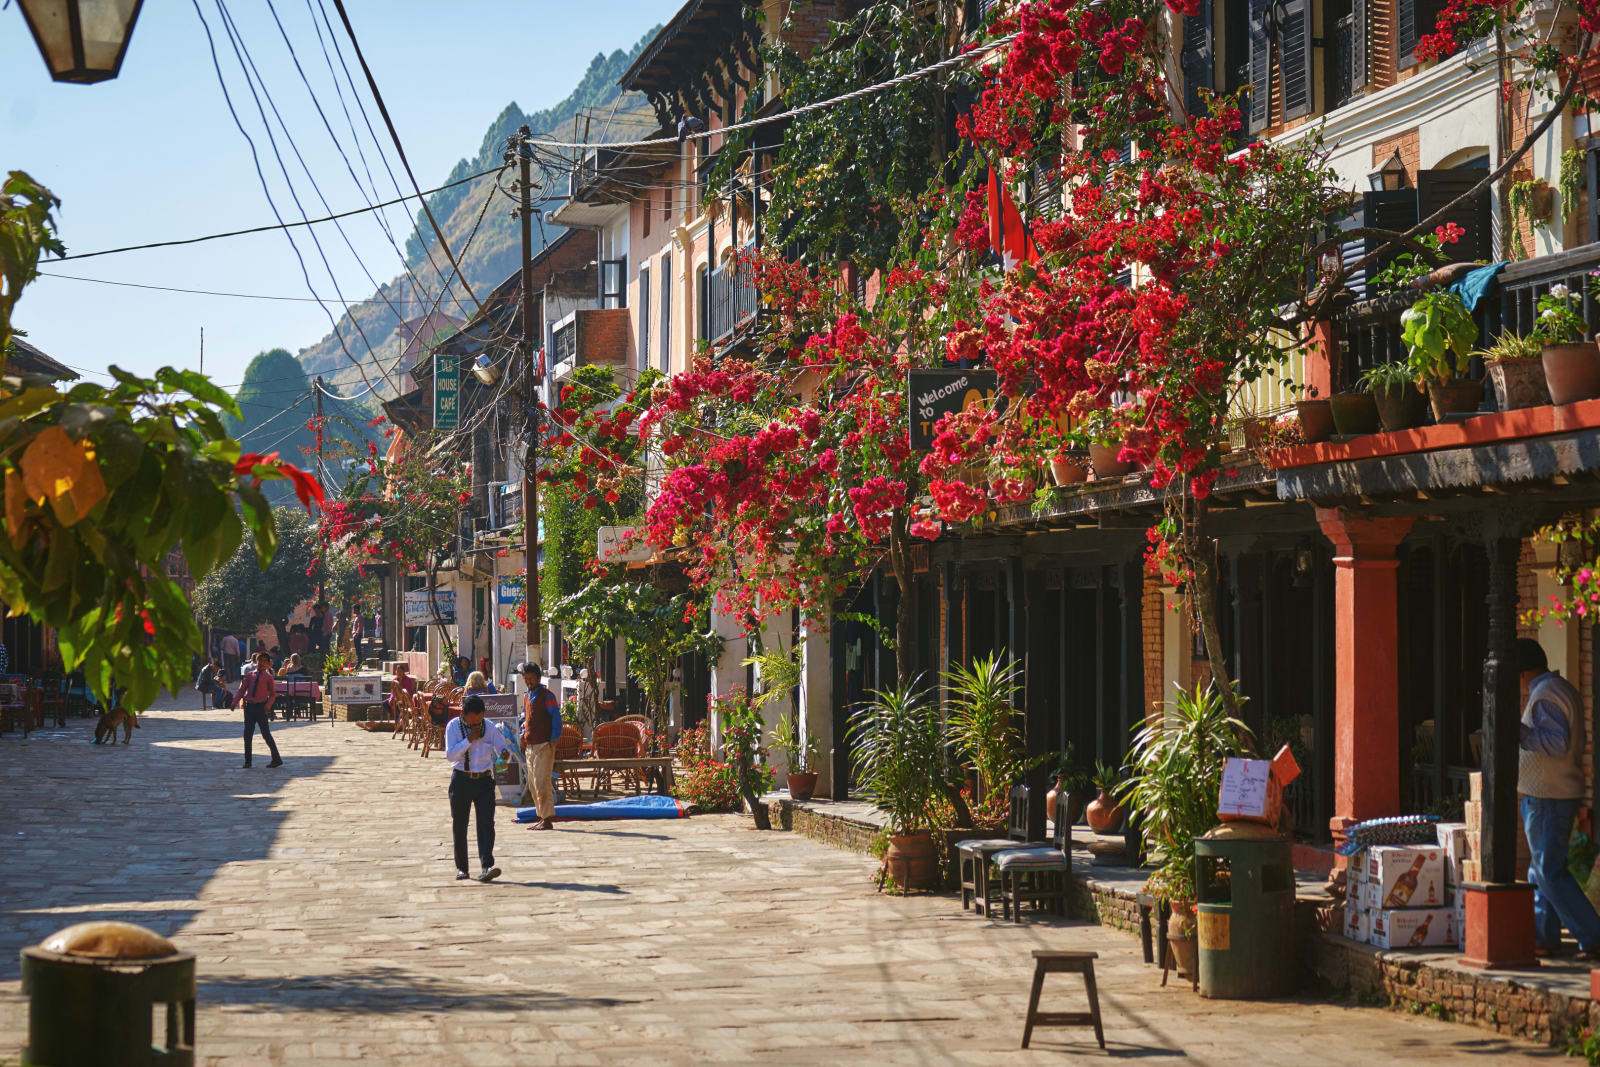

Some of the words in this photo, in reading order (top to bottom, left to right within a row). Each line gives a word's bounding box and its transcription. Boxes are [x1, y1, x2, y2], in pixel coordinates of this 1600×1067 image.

[437, 378, 457, 392] HOUSE
[917, 376, 969, 407] Welcome
[919, 405, 934, 420] to
